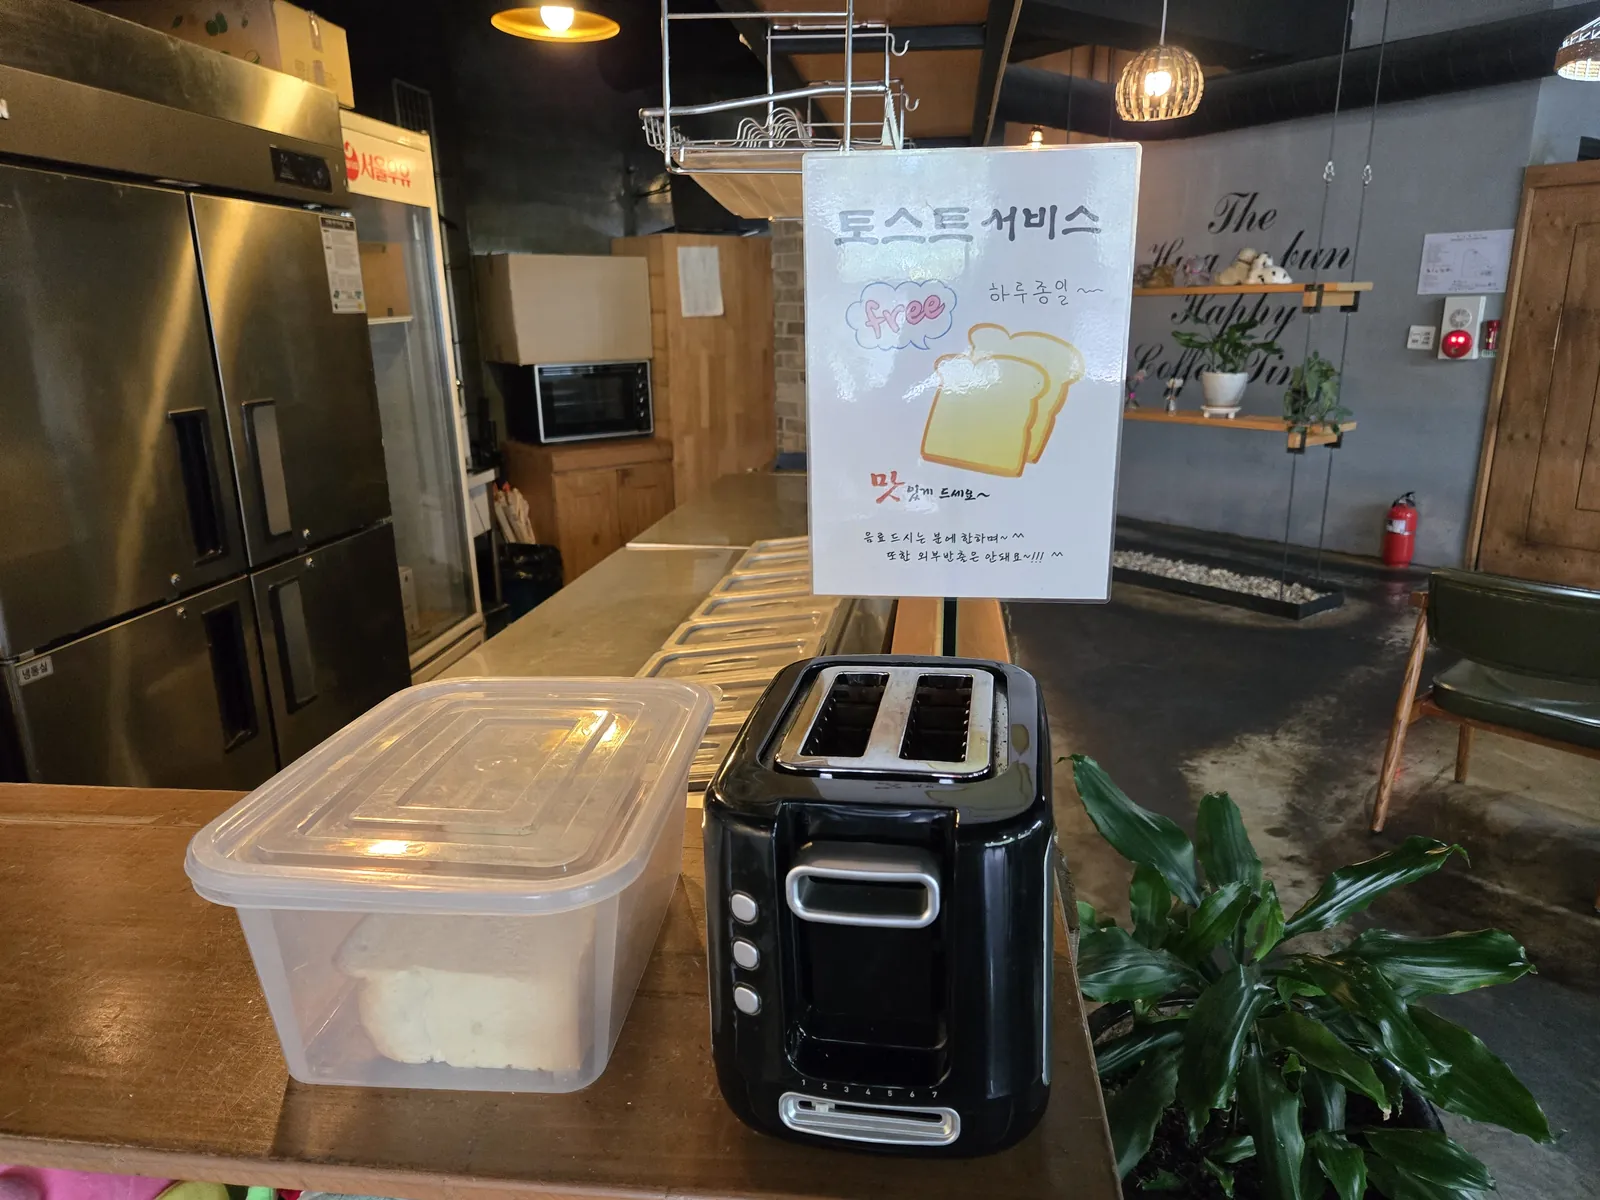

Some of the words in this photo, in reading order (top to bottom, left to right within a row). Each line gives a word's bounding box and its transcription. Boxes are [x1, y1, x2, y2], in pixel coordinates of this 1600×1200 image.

[1208, 191, 1277, 235] The
[864, 294, 946, 340] free
[1171, 293, 1298, 341] Happy
[864, 531, 886, 544] 음료
[890, 532, 926, 544] 드시는
[932, 532, 956, 545] 분에
[886, 550, 911, 562] 또한
[21, 661, 48, 680] 냉동실
